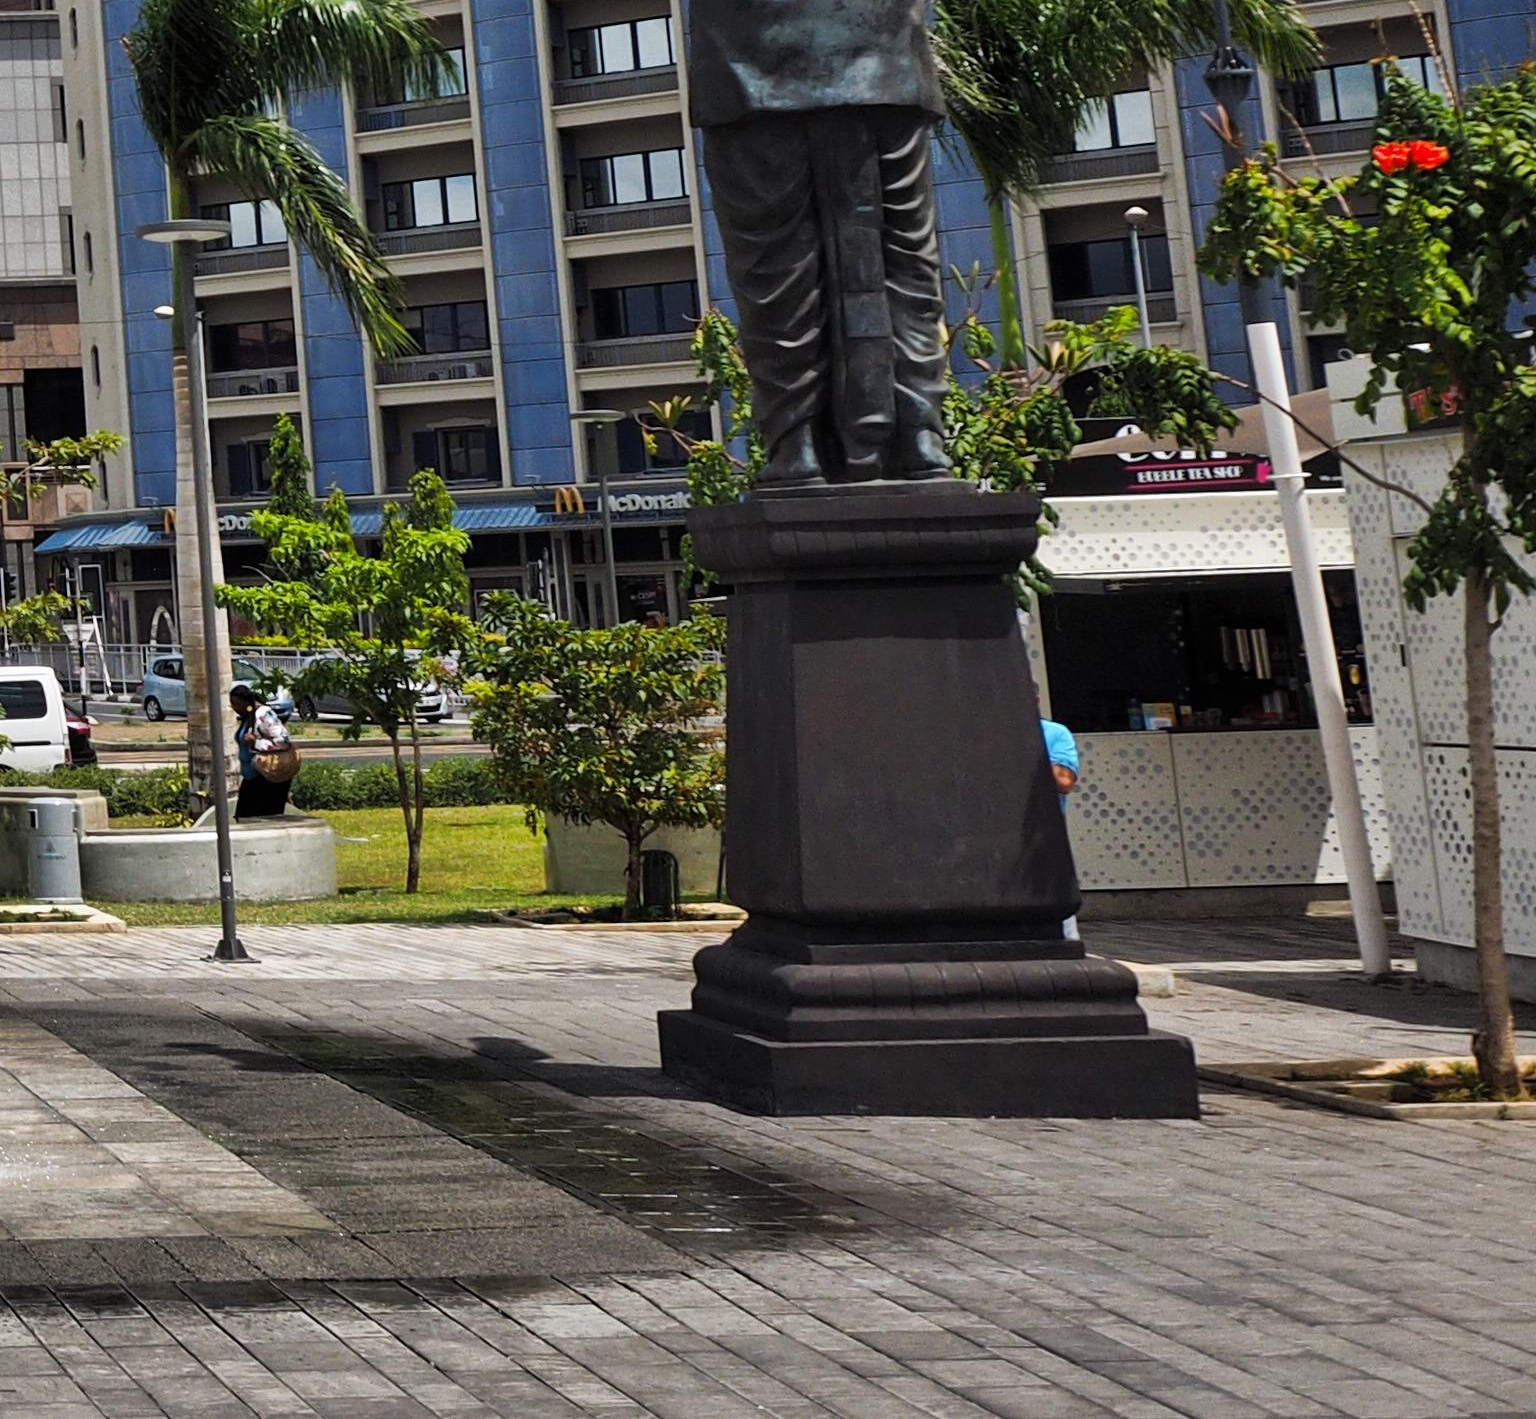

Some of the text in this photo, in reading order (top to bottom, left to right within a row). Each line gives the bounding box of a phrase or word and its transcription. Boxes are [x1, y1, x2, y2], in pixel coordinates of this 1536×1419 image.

[1136, 465, 1244, 483] BUBBLE TEA SHOP
[597, 491, 693, 512] McDonal
